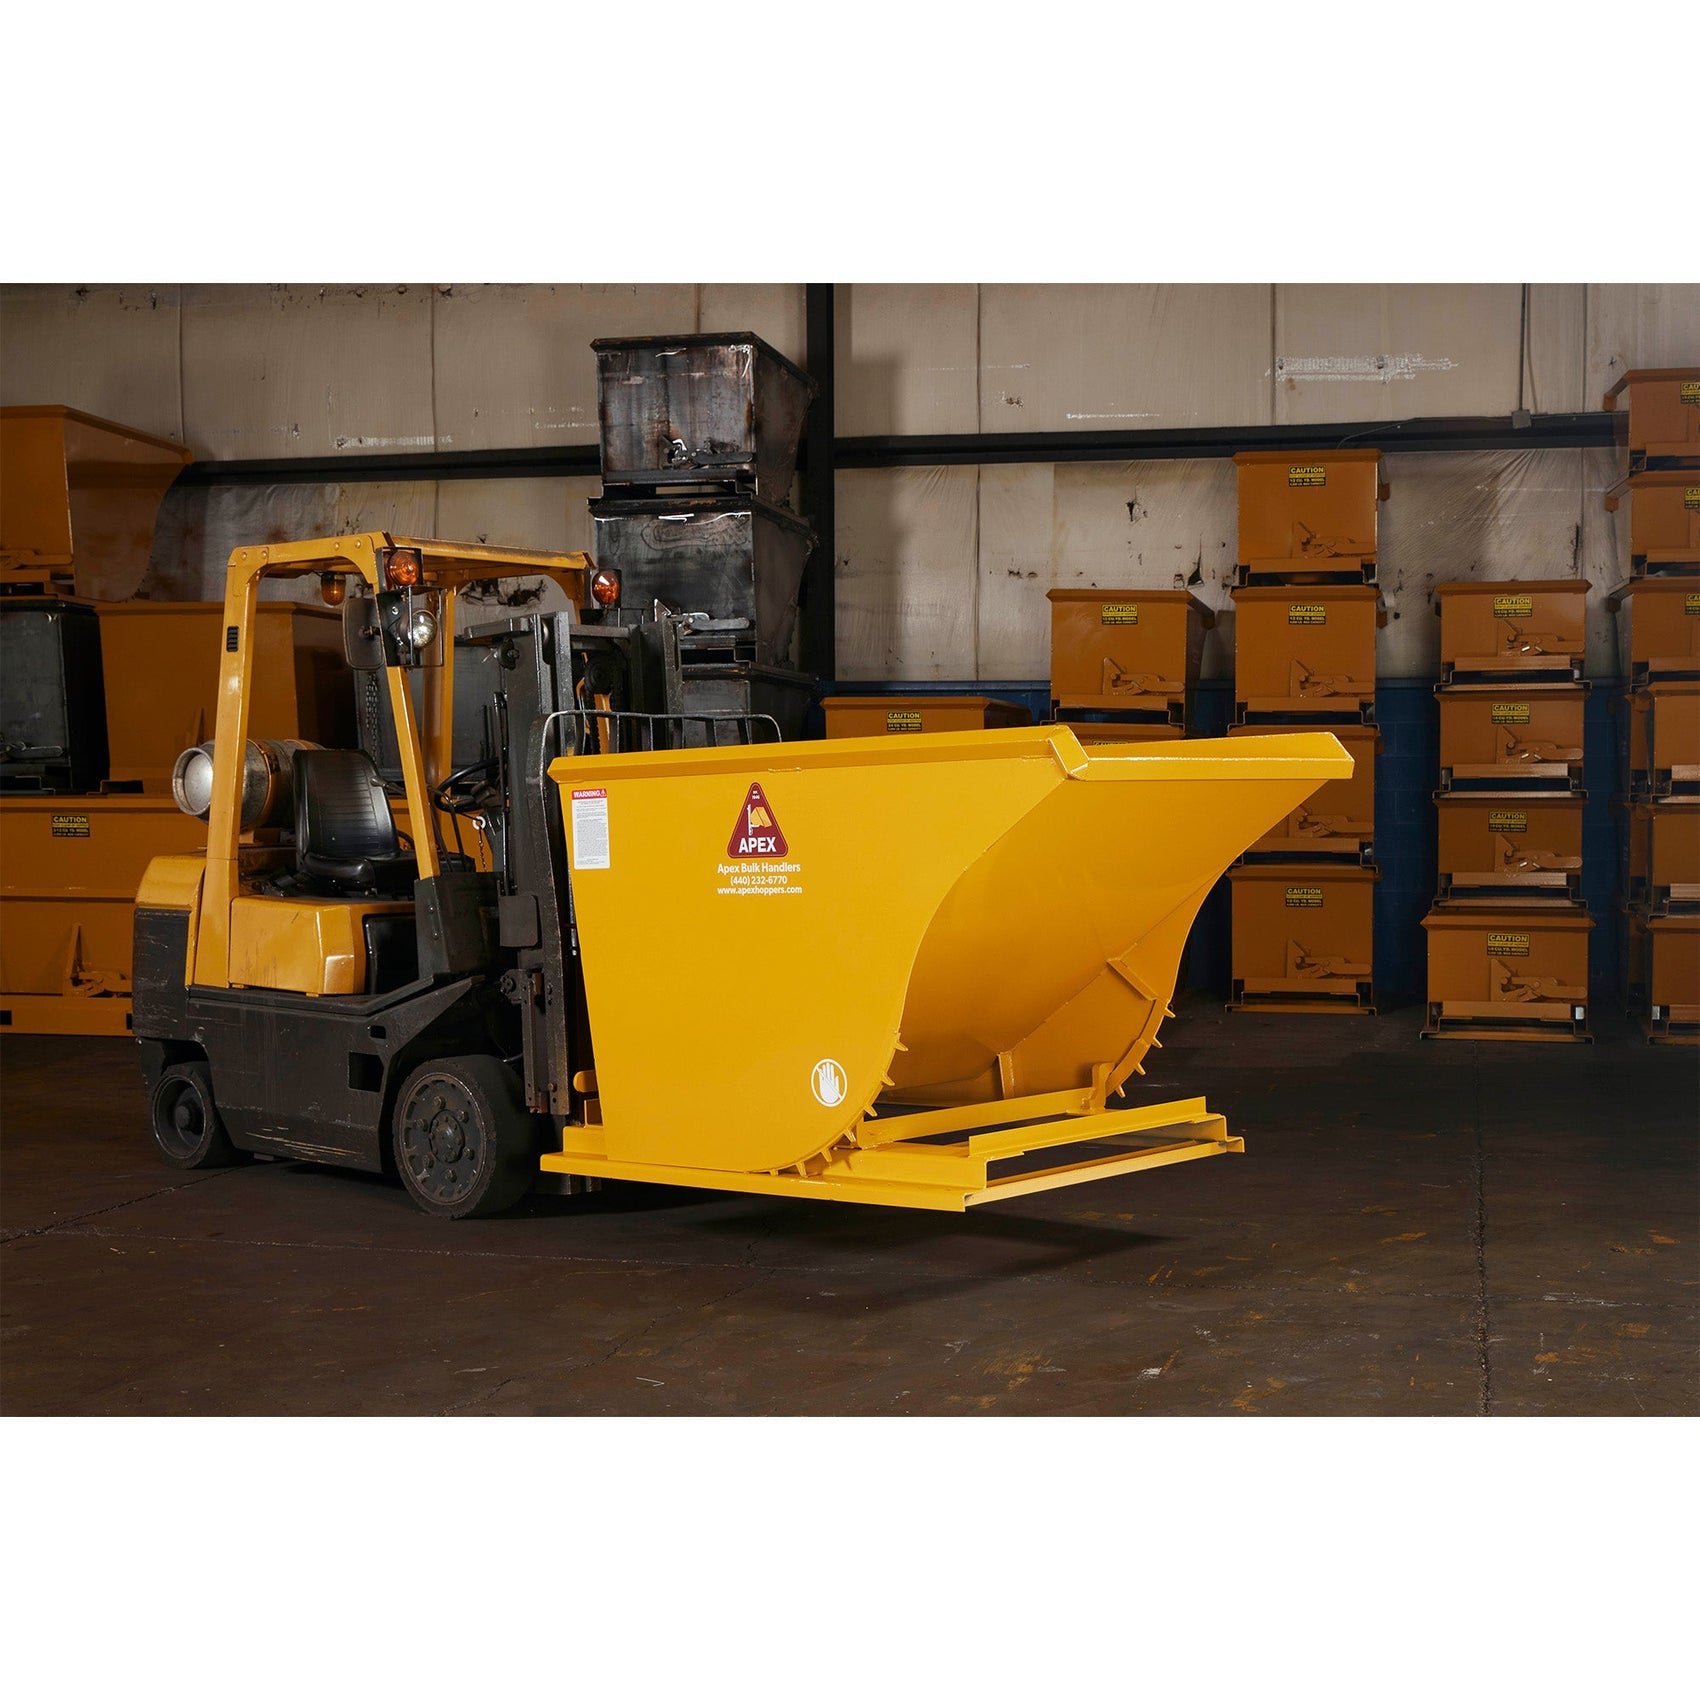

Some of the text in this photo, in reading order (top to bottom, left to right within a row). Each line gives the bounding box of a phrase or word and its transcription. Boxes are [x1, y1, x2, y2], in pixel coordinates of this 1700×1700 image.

[573, 790, 600, 798] WARNING
[738, 836, 777, 853] APEX
[717, 861, 801, 876] Apex Bulk Handlers
[730, 875, 788, 886] (440) 232-6770
[717, 886, 803, 895] www.apexhoppers.com
[1490, 934, 1527, 942] CAUTION
